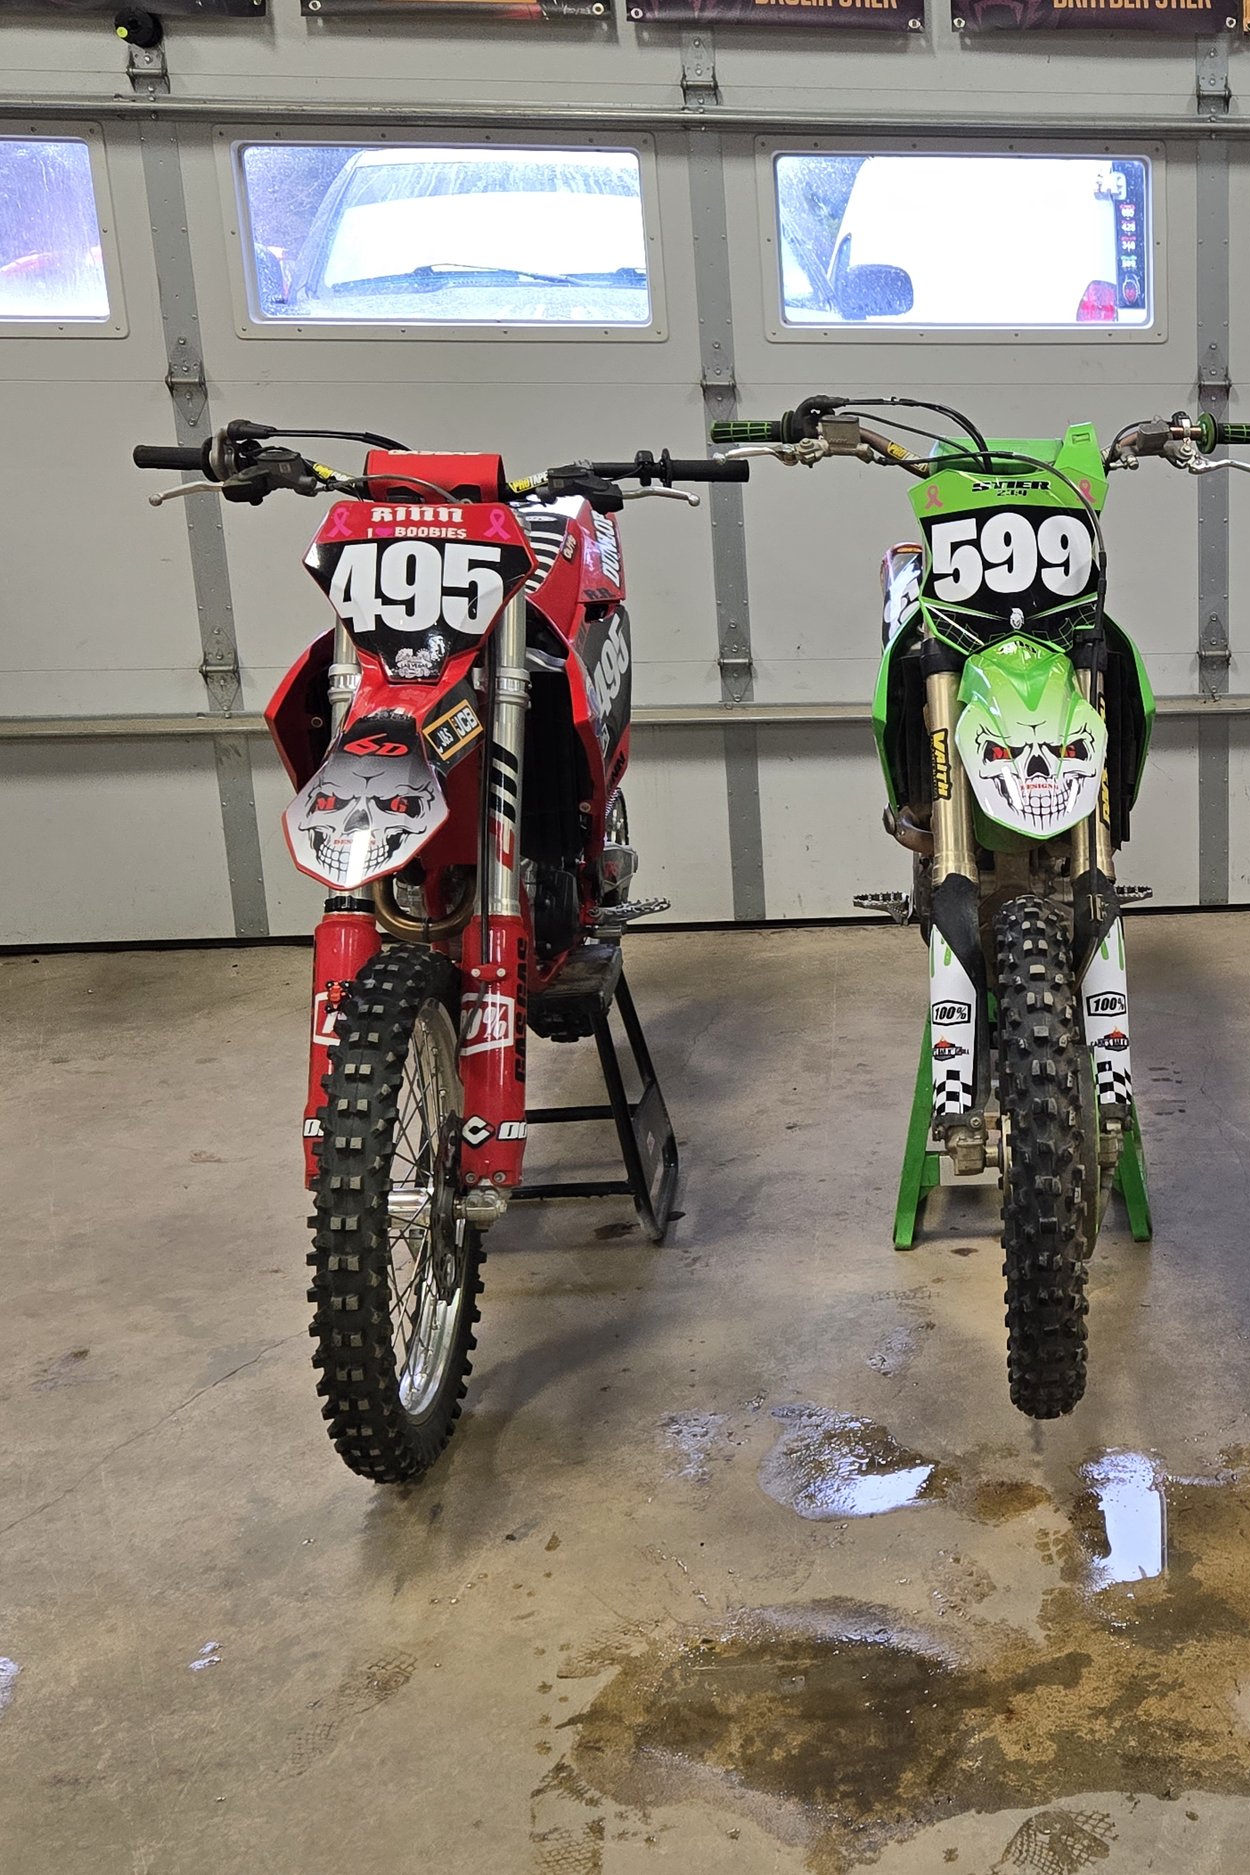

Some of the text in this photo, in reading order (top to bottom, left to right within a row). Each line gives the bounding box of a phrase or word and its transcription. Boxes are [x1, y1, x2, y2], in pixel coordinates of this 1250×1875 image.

[971, 480, 1051, 493] STIER
[367, 527, 467, 539] I BOOBIES
[931, 512, 1092, 602] 599
[329, 540, 504, 635] 495
[594, 613, 630, 719] 495
[455, 706, 480, 736] JCB
[934, 1005, 968, 1021] 100%
[1093, 997, 1125, 1012] 100%
